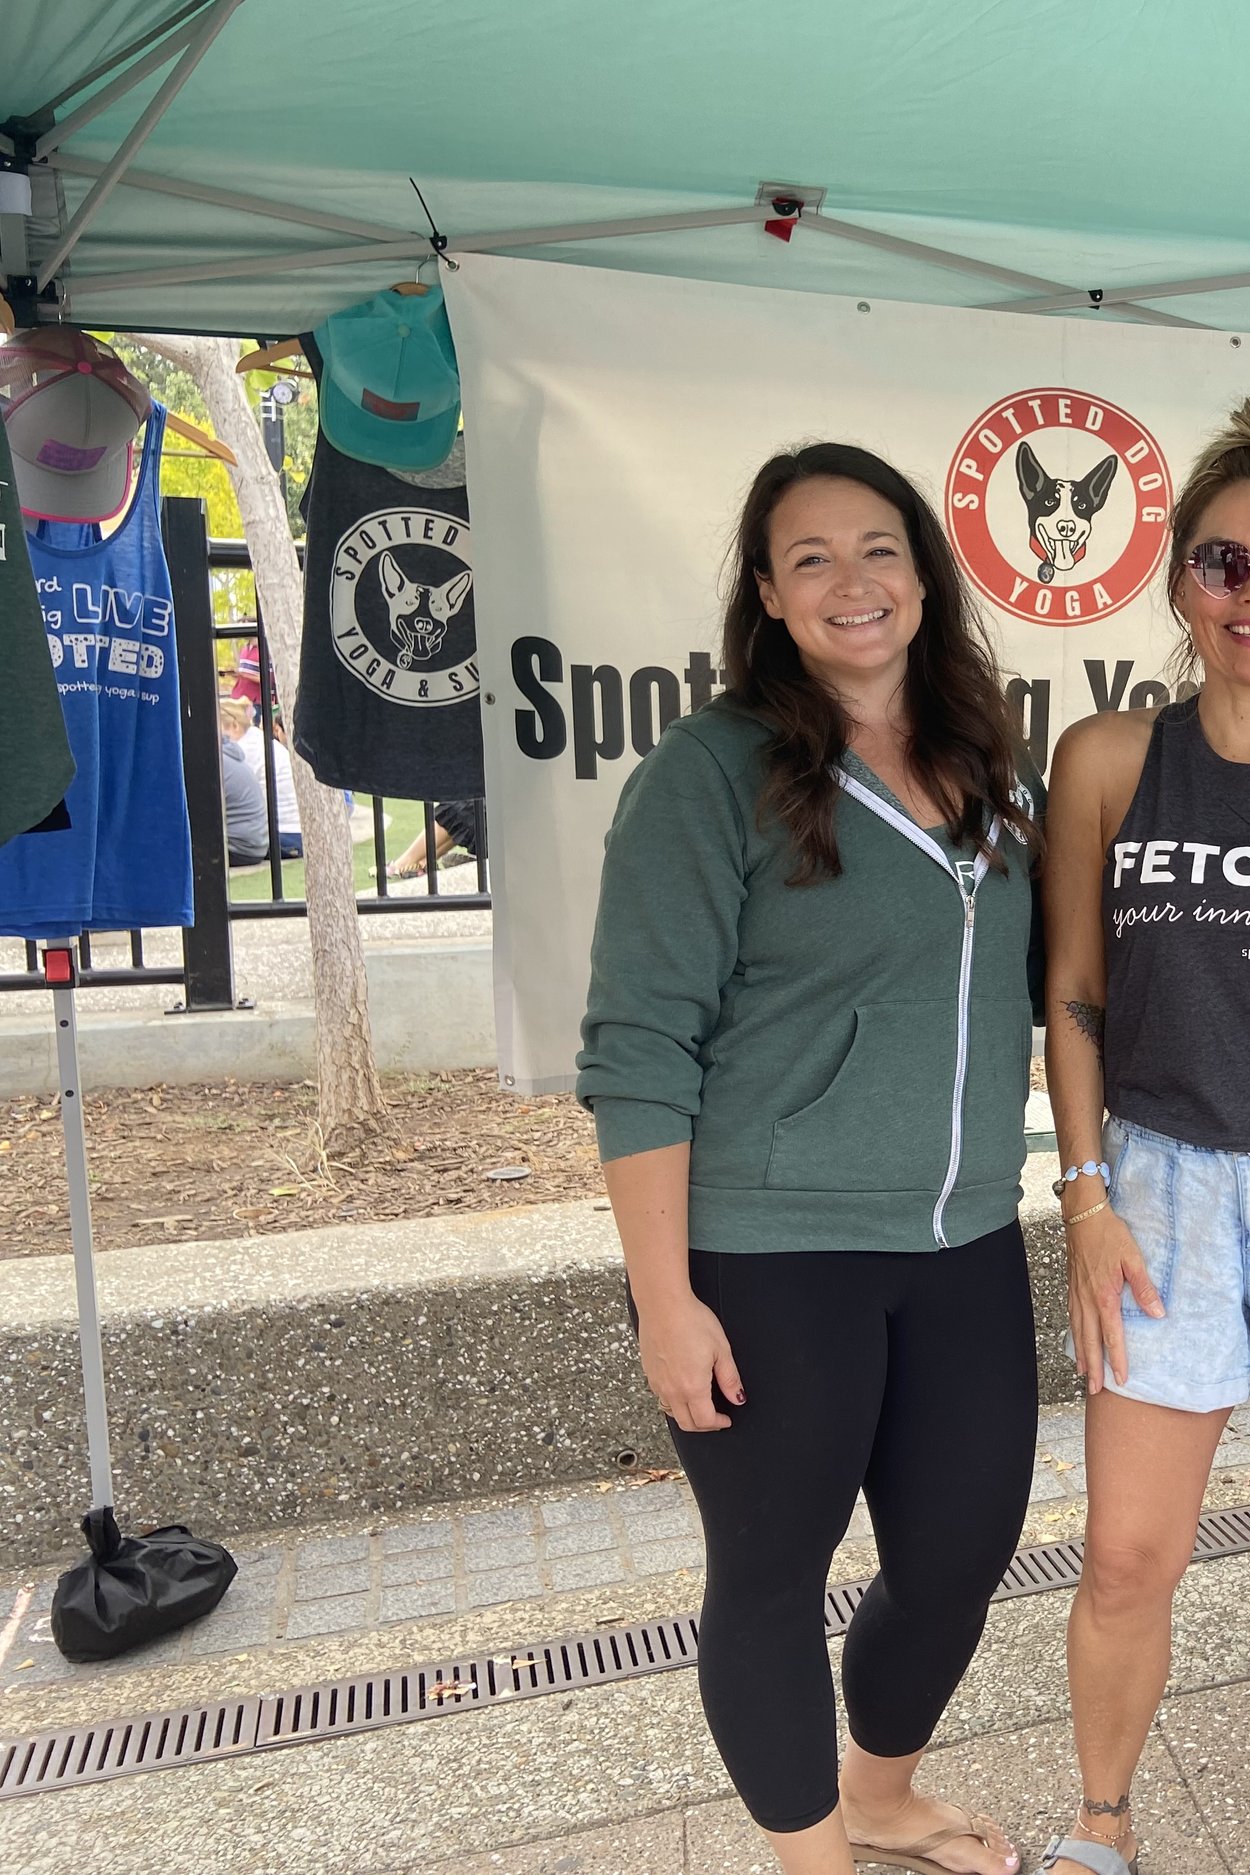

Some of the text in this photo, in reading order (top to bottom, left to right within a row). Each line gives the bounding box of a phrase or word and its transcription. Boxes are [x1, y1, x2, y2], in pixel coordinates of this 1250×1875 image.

[952, 398, 1166, 523] SPOTTED DOG
[335, 516, 459, 581] SPOTTED
[41, 604, 62, 630] ig
[72, 583, 171, 637] LIVE
[1008, 576, 1113, 617] YOGA
[337, 626, 480, 698] YOGA & SU
[510, 636, 728, 780] Spot
[1112, 902, 1184, 939] your
